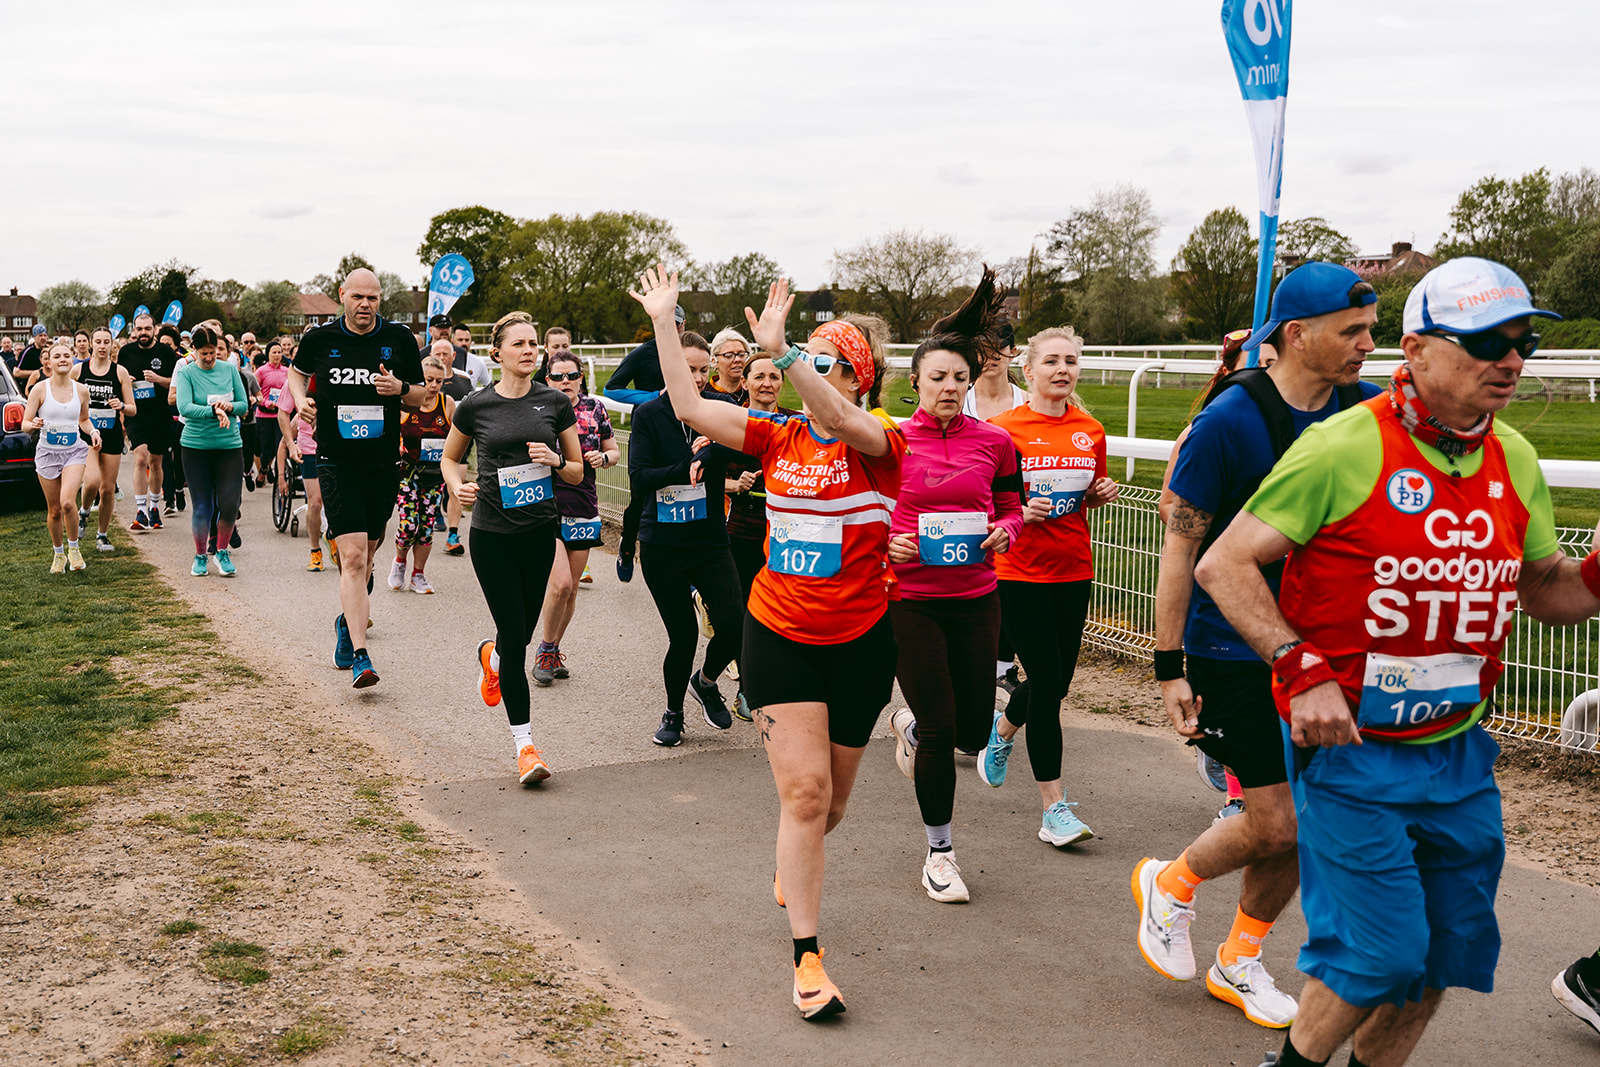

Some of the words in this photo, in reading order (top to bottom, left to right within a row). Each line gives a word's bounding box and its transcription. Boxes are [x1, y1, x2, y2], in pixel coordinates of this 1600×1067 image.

[439, 262, 464, 286] 65
[1456, 286, 1527, 312] FINISHER
[169, 304, 181, 321] 70
[113, 315, 122, 327] 75
[328, 367, 393, 385] 32Re
[135, 389, 150, 399] 306
[96, 418, 108, 429] 76
[340, 412, 353, 421] 10k
[351, 424, 369, 438] 36
[56, 434, 69, 446] 75
[1021, 456, 1060, 470] SELBY
[502, 476, 520, 486] 10k
[820, 471, 850, 488] CUB
[514, 485, 545, 505] 283
[786, 487, 818, 498] Cassie
[1035, 483, 1054, 493] 10k
[660, 494, 675, 503] 10k
[670, 506, 695, 521] 111
[569, 526, 595, 540] 232
[772, 526, 790, 539] 10k
[923, 525, 945, 536] 10k
[942, 542, 968, 563] 56
[780, 548, 822, 574] 107
[1373, 552, 1522, 590] goodgym
[1376, 664, 1407, 674] TEWV
[1374, 673, 1409, 689] 10k
[1389, 700, 1453, 725] 100
